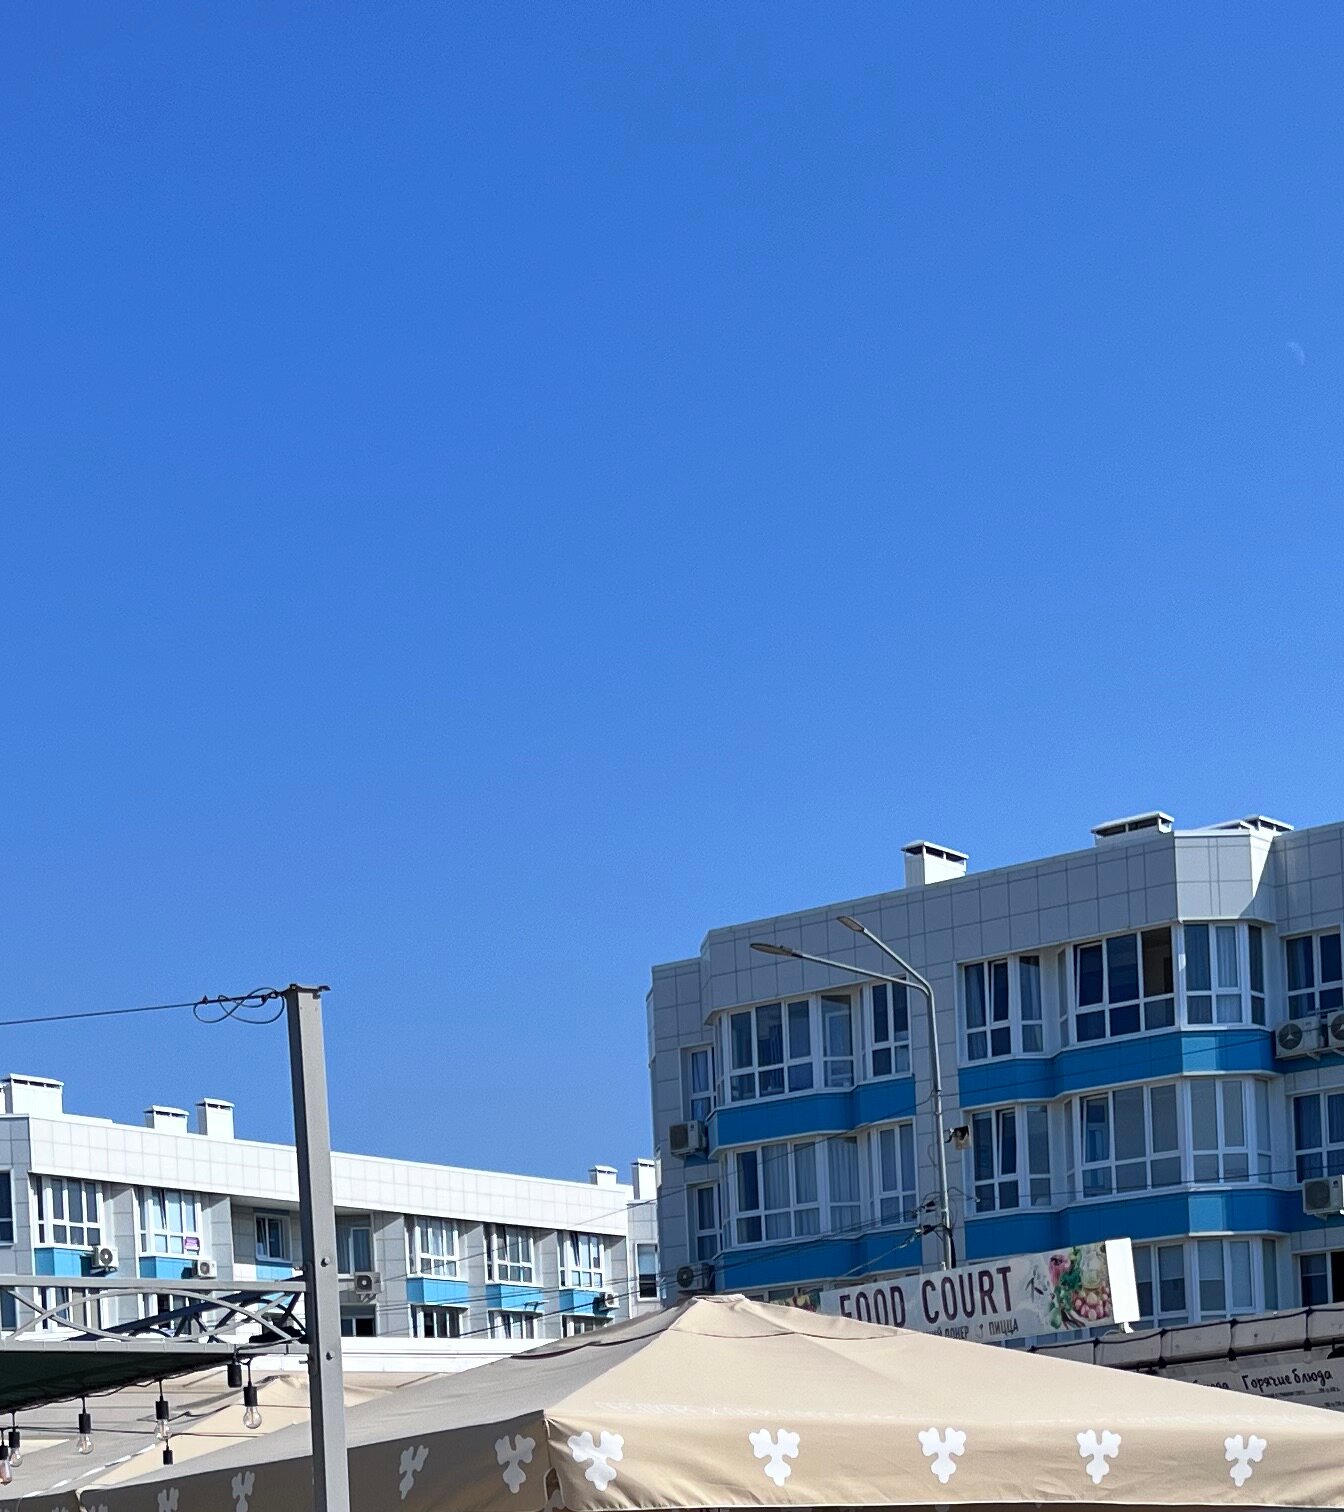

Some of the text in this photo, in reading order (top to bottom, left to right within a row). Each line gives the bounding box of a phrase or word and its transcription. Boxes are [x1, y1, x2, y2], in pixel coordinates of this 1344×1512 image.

[839, 1266, 1012, 1327] FOOD COURT
[989, 1319, 1019, 1336] ПИЦЦА
[1241, 1374, 1292, 1393] Горячие
[1292, 1368, 1333, 1386] блюда
